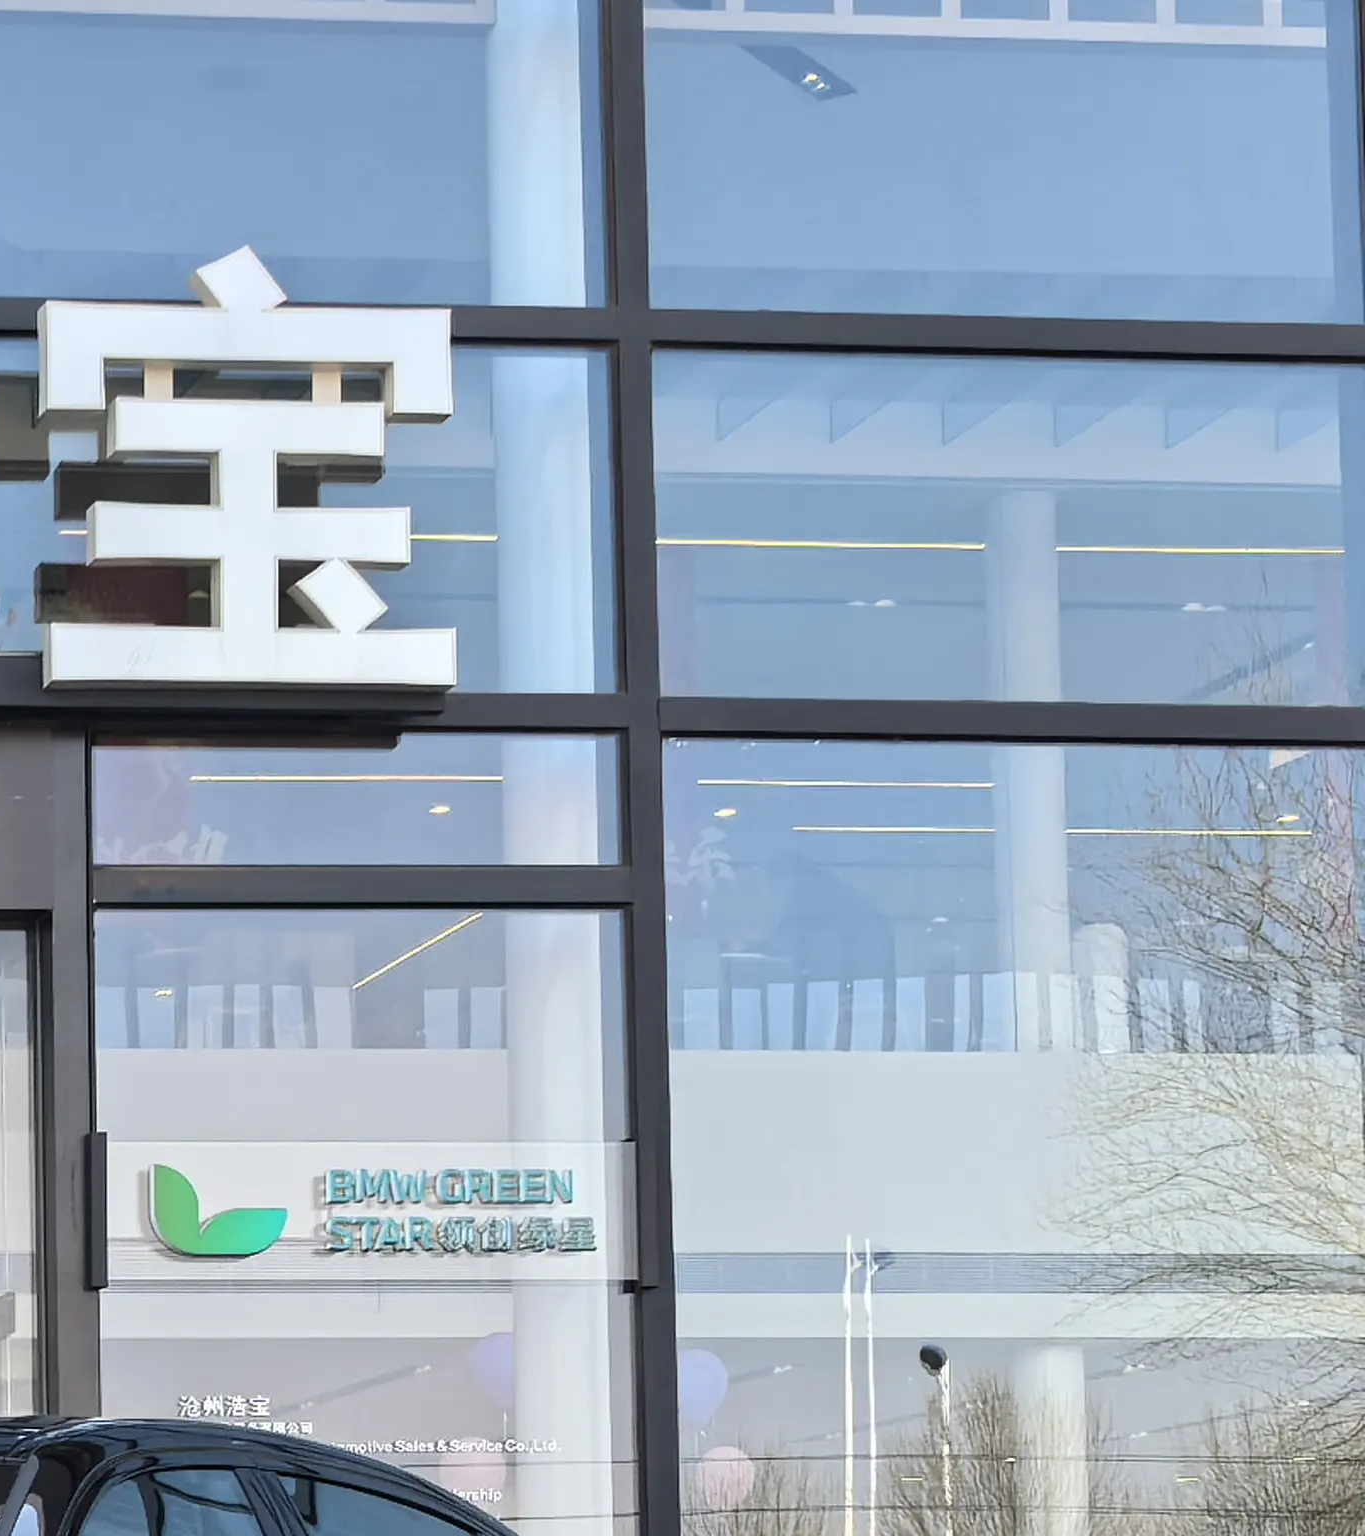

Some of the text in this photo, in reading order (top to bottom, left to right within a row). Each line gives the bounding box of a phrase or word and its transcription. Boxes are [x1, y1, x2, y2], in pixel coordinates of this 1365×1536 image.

[324, 1168, 575, 1205] BMW GREEN
[177, 1394, 273, 1418] 沧州浩宝
[393, 1439, 435, 1453] Sales
[436, 1439, 450, 1453] &
[450, 1438, 503, 1453] Service
